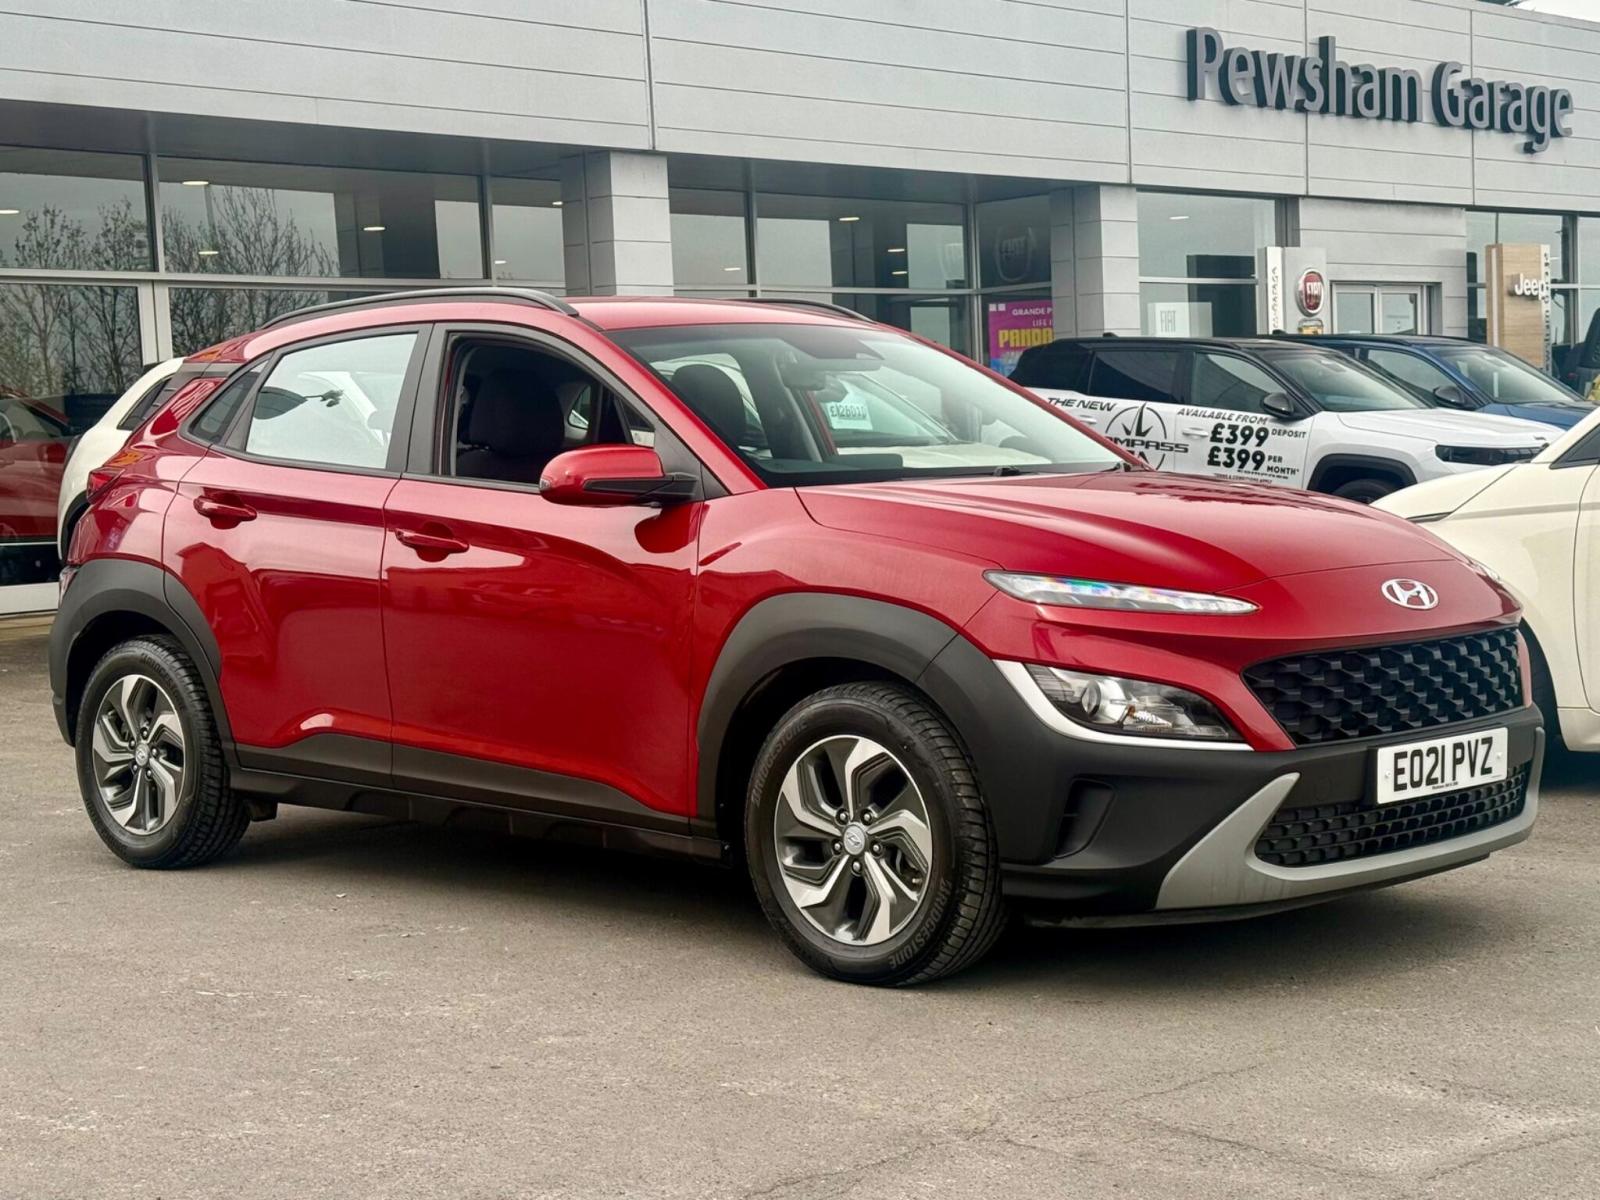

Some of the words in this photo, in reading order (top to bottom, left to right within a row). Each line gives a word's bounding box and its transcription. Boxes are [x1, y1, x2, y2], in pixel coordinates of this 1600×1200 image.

[1186, 26, 1423, 122] Pewsham
[1431, 60, 1574, 153] Garage
[1514, 272, 1546, 300] Jeep
[1011, 308, 1046, 316] GRANDE
[1047, 397, 1077, 407] THE
[1076, 399, 1117, 412] NEW
[1177, 407, 1233, 421] AVAILABLE
[1235, 414, 1268, 425] FROM
[1209, 422, 1269, 447] £399
[1271, 428, 1307, 438] DEPOSIT
[1207, 445, 1266, 471] £399
[1268, 455, 1283, 463] PER
[1393, 744, 1446, 793] EO21
[1452, 736, 1493, 782] PVZ
